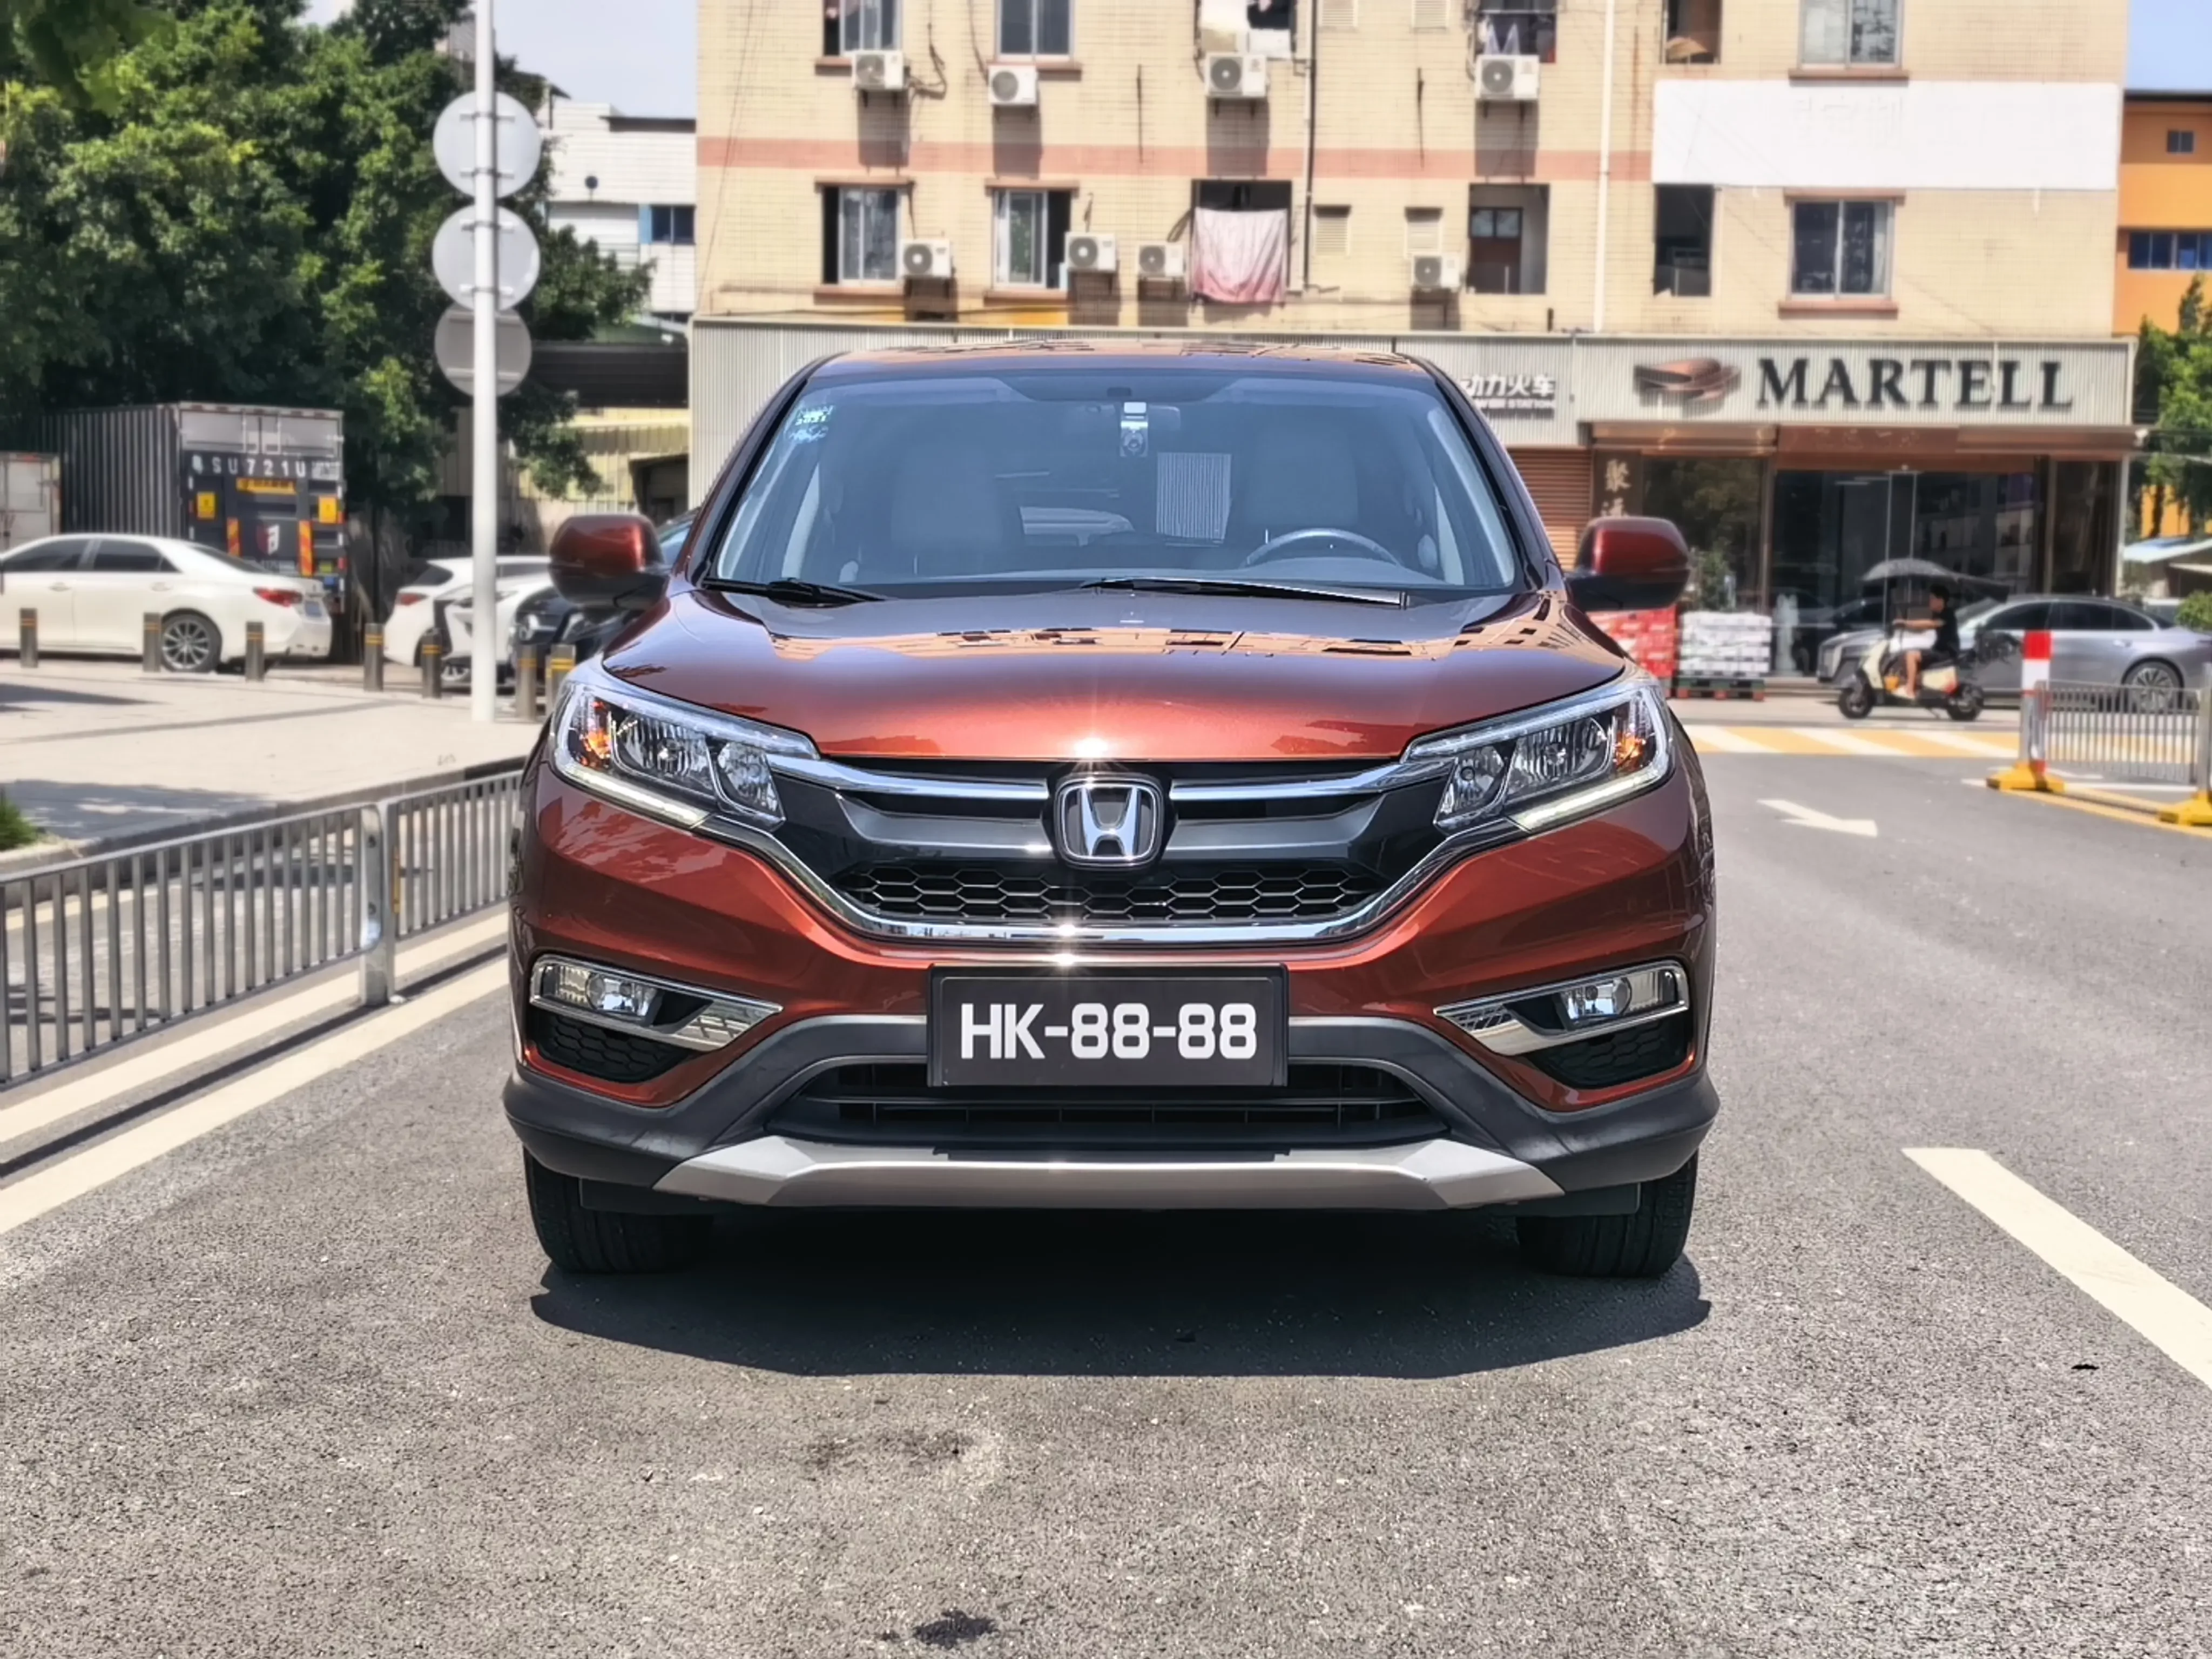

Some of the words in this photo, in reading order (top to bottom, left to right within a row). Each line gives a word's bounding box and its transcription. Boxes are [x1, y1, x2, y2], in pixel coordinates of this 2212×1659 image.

[1460, 374, 1555, 397] 动力火车
[1757, 358, 2073, 413] MARTELL
[961, 1003, 1257, 1059] HK-88-88
